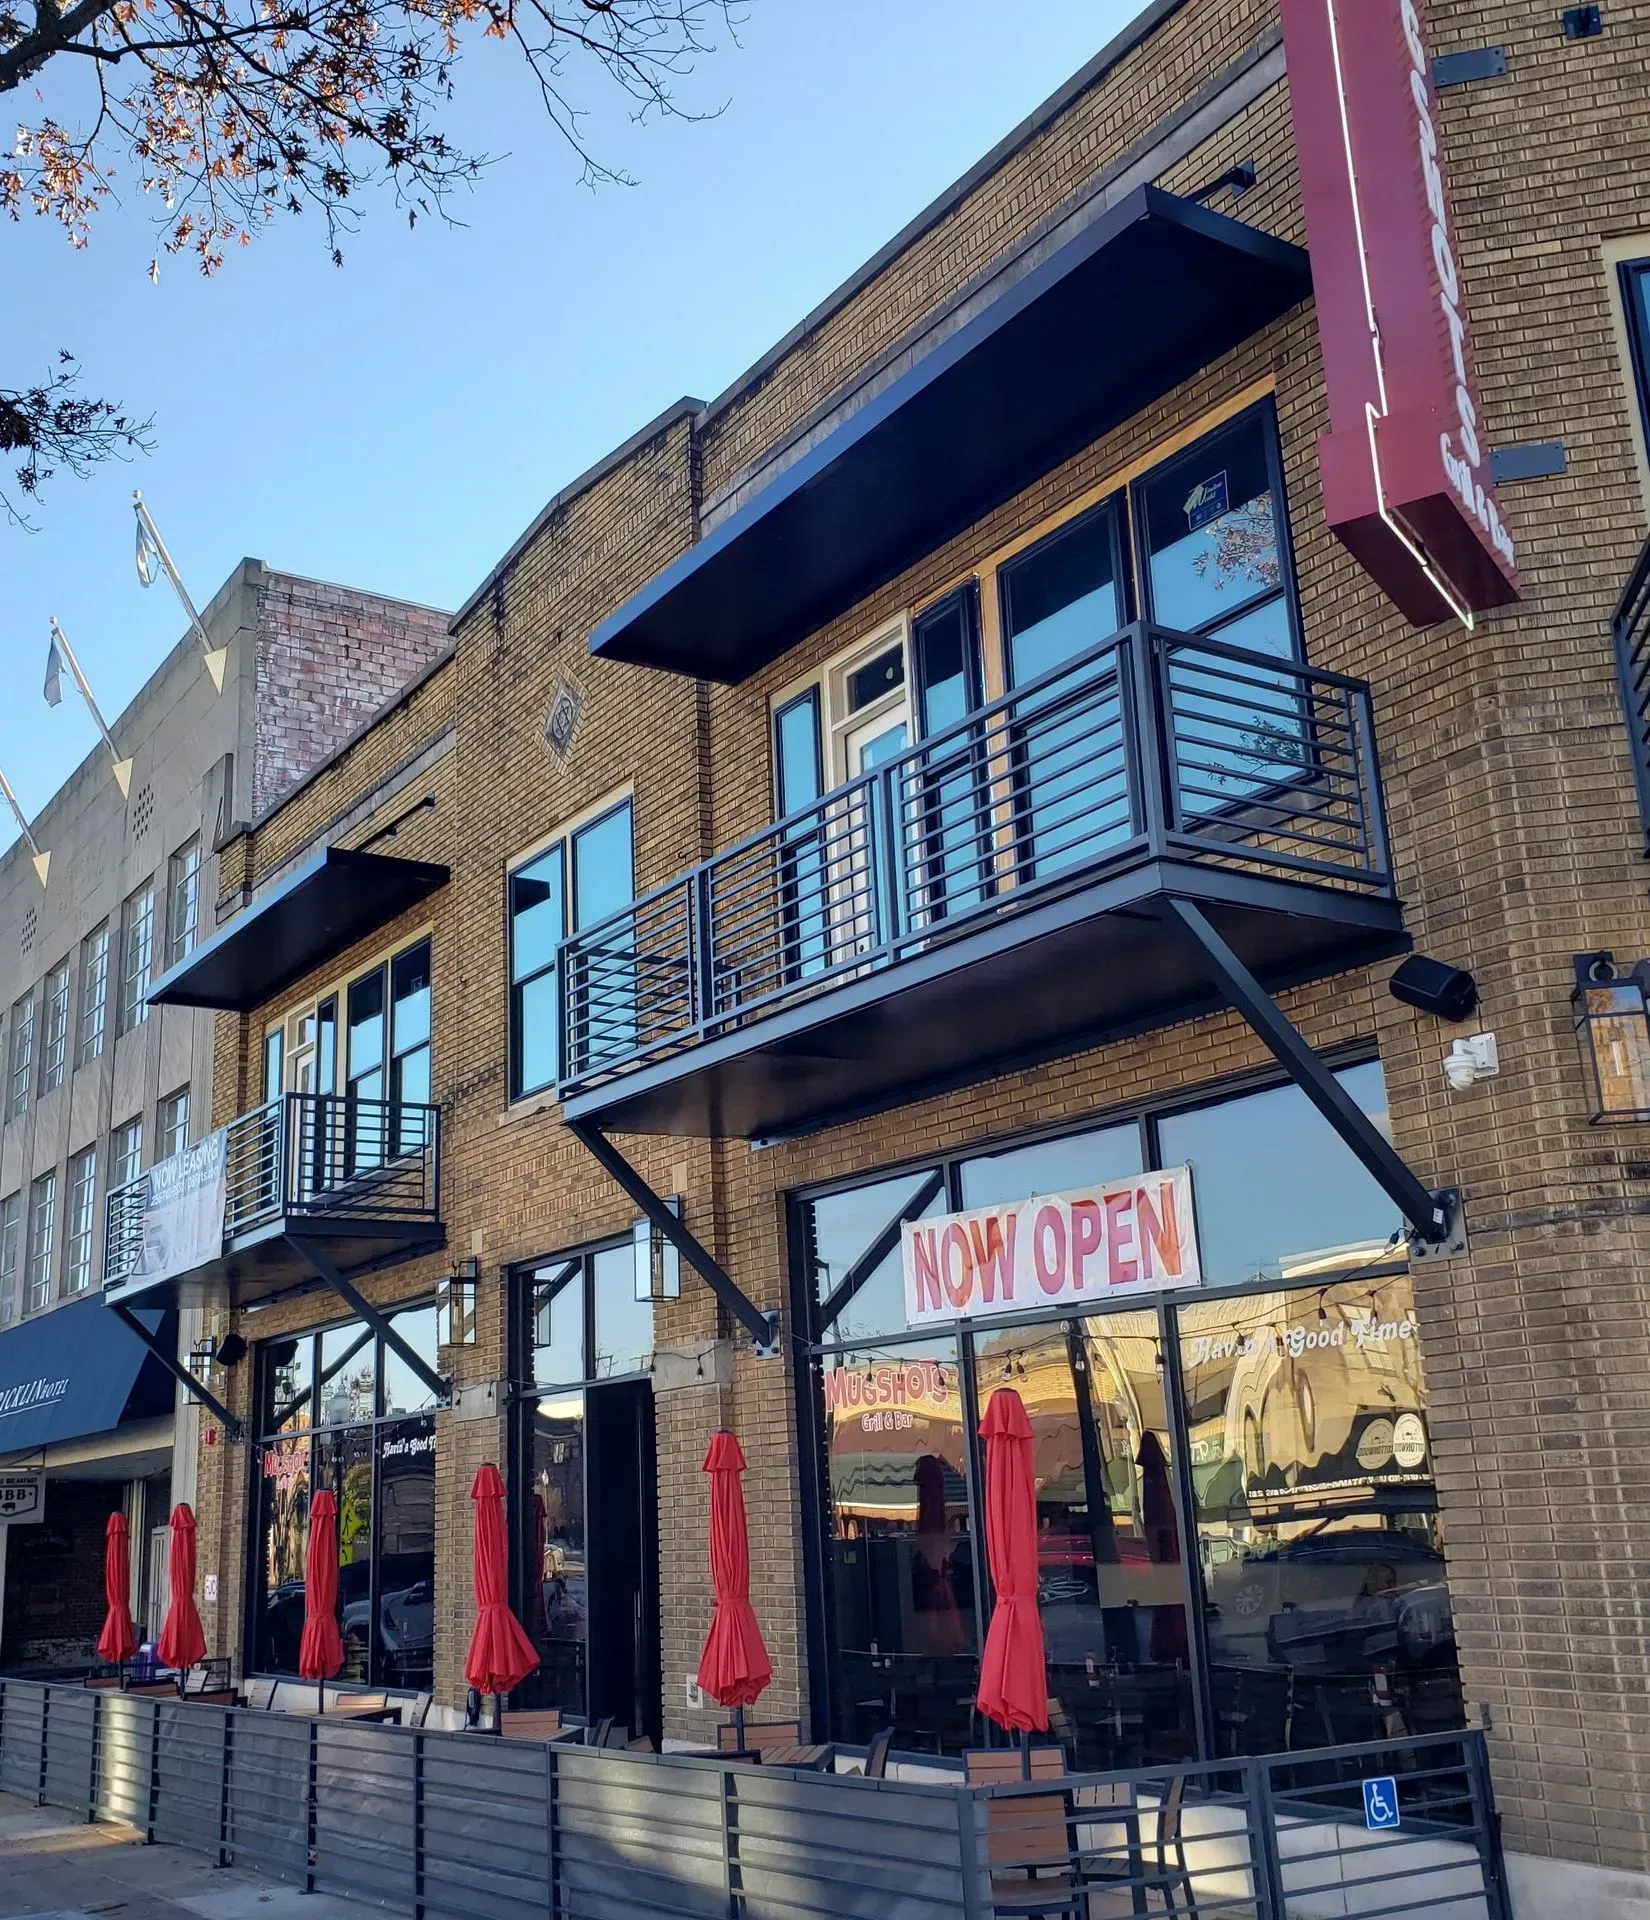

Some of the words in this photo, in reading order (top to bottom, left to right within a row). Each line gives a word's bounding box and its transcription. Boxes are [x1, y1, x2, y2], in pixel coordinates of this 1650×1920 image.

[153, 1154, 178, 1191] NOW
[178, 1137, 219, 1179] LEASING
[913, 1213, 1017, 1313] NOW
[1033, 1181, 1183, 1295] OPEN
[1283, 1320, 1344, 1358] Good
[1350, 1315, 1412, 1349] Time
[824, 1365, 949, 1413] MUGSHOTS
[861, 1411, 883, 1432] Grill
[884, 1411, 893, 1430] &
[894, 1411, 914, 1430] Bar
[410, 1436, 428, 1456] Good
